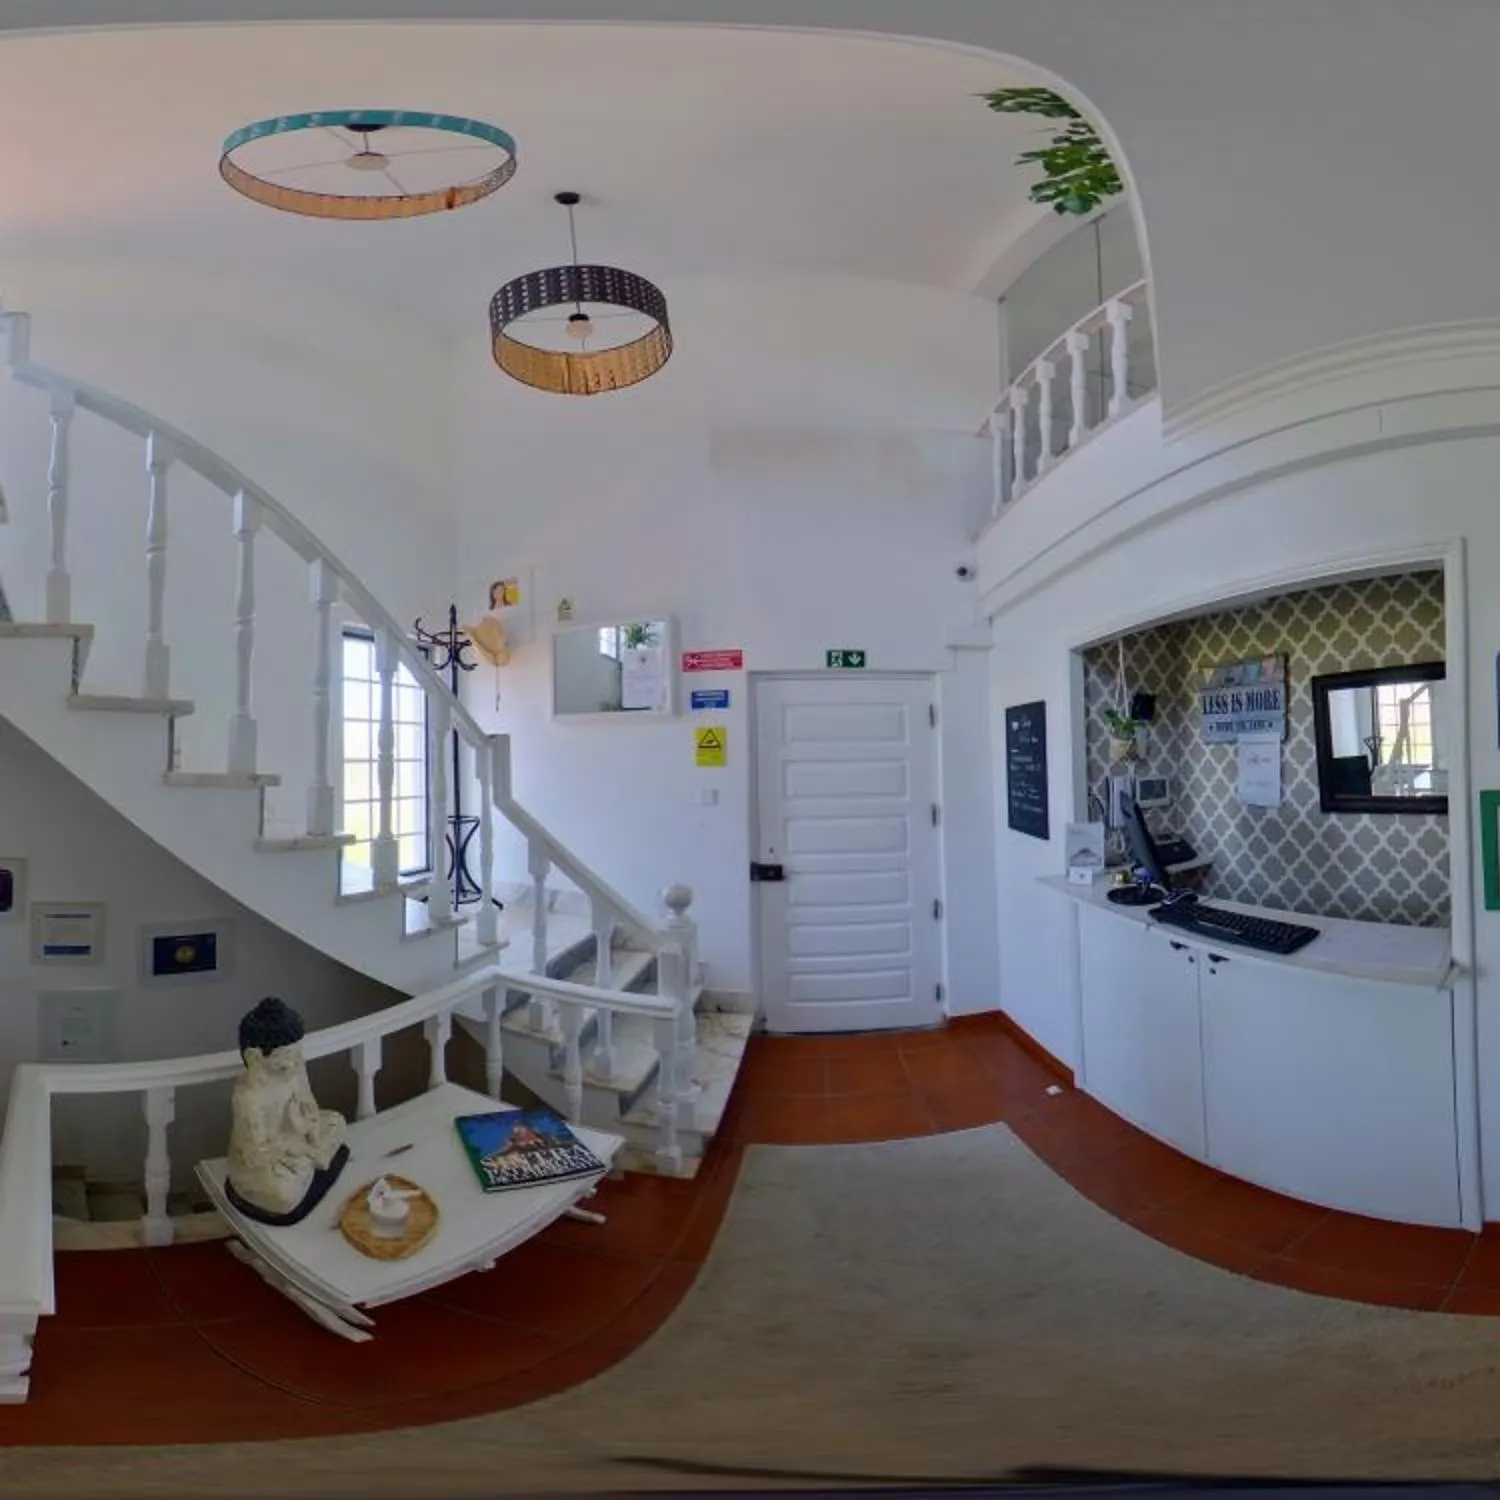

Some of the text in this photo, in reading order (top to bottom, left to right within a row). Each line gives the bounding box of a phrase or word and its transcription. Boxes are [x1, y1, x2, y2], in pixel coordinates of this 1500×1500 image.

[1202, 688, 1280, 714] LESS IS MORE
